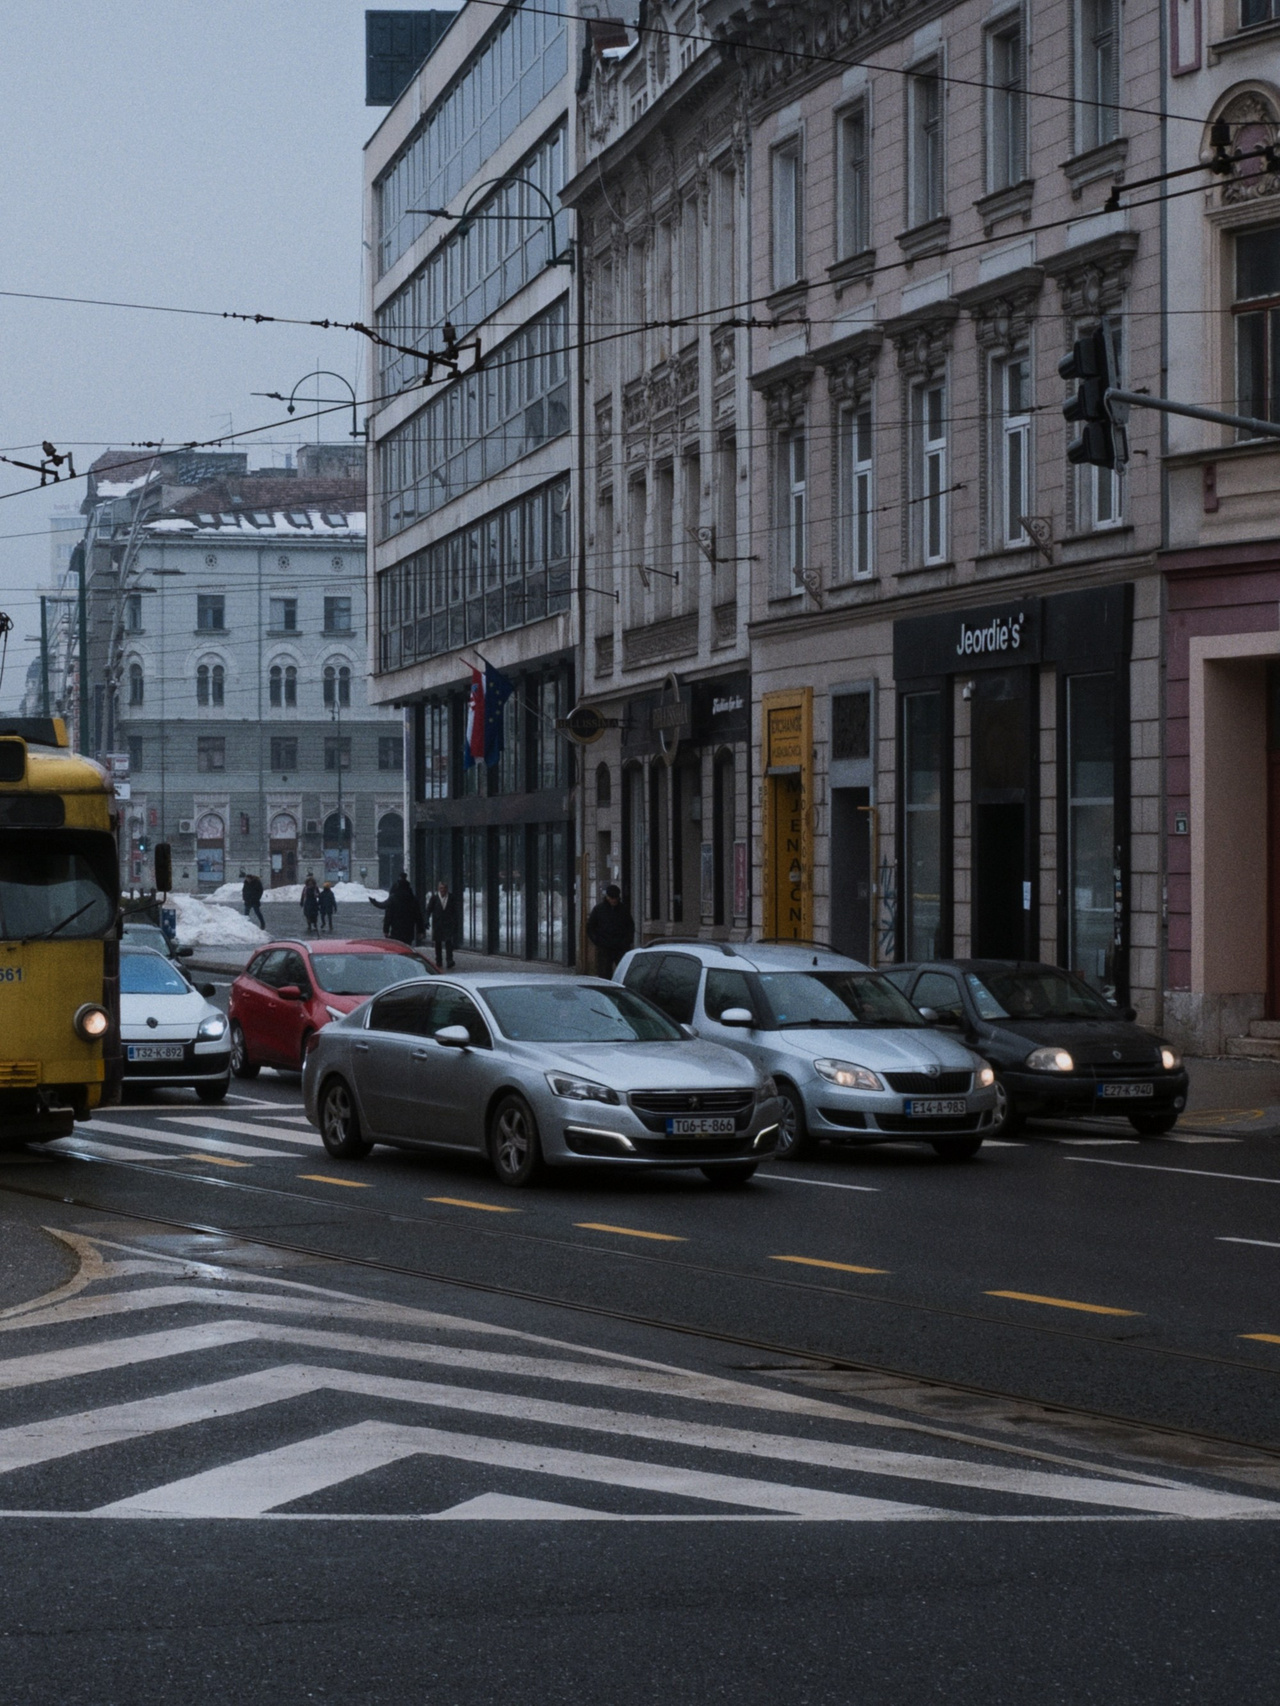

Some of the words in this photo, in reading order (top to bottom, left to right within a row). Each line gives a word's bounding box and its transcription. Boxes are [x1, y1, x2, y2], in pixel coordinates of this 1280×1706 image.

[135, 1046, 182, 1058] T32-K-892
[1104, 1084, 1152, 1096] E27-K-940
[913, 1101, 965, 1114] E14-A-983
[675, 1119, 733, 1133] T06-E-866
